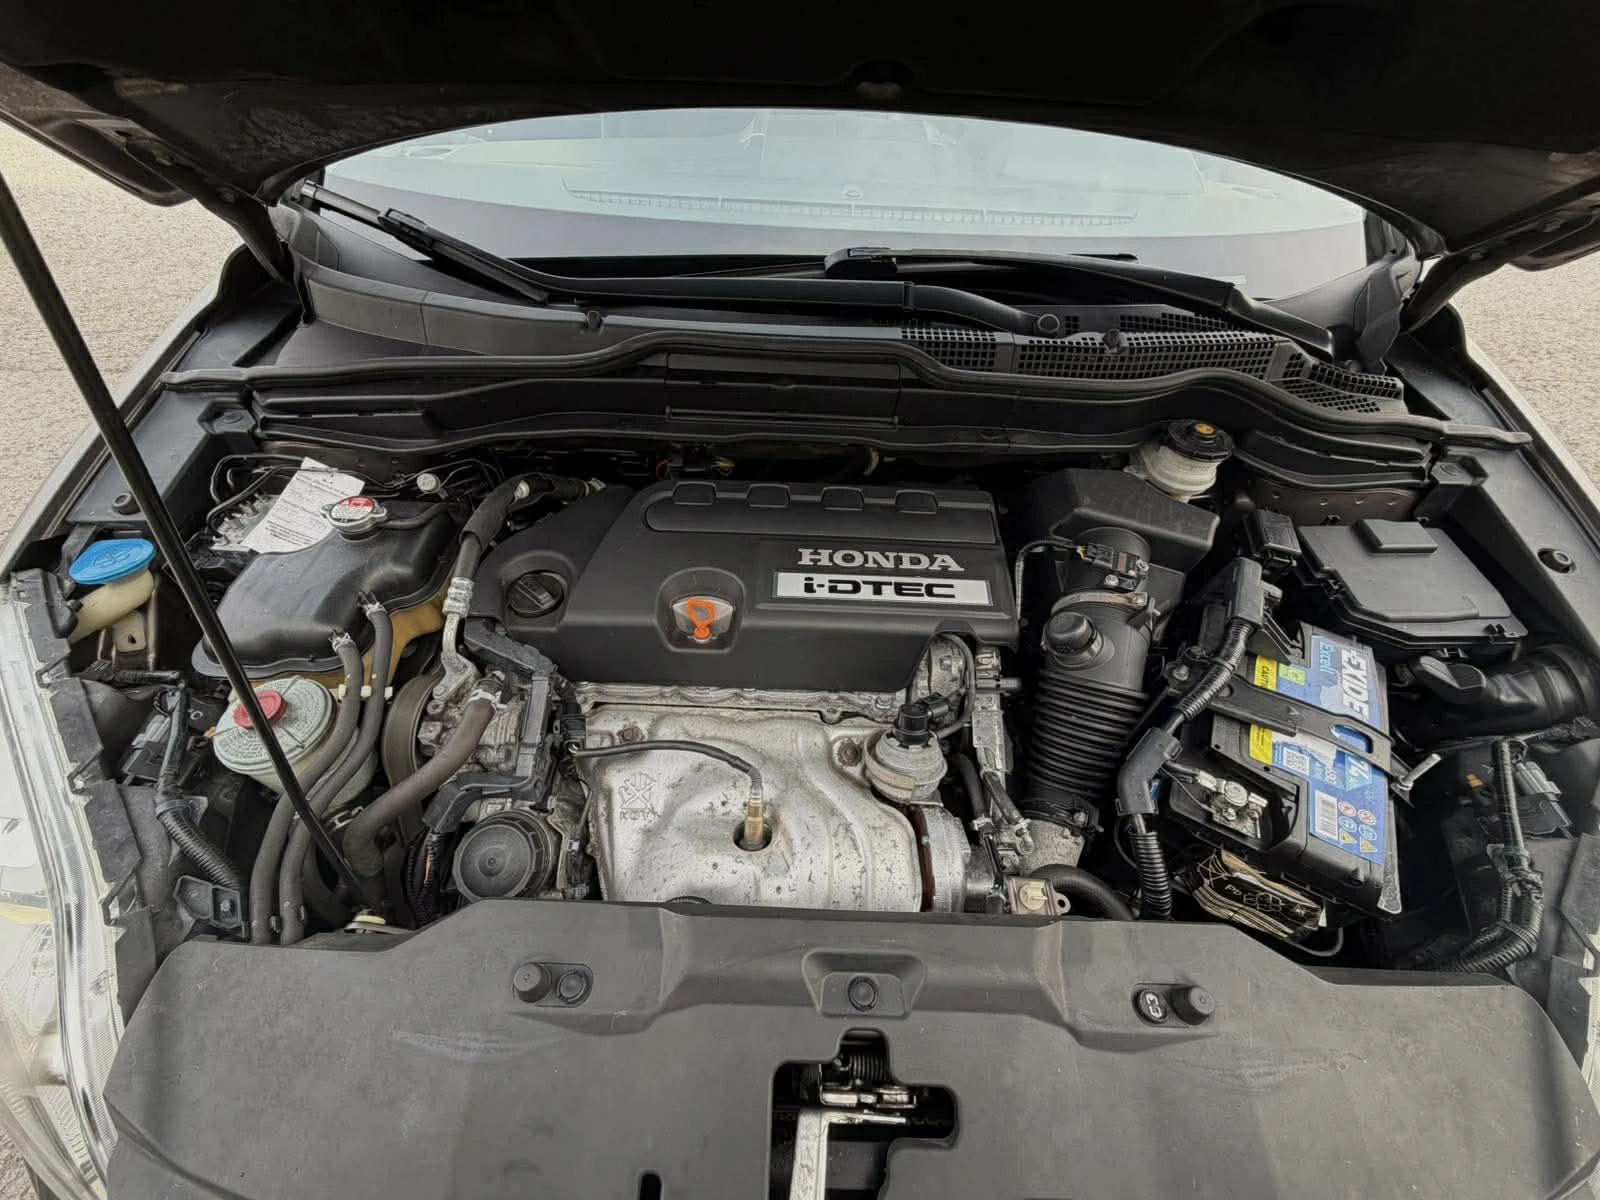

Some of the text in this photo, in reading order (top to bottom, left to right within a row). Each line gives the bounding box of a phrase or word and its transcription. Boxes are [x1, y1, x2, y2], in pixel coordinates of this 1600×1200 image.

[798, 548, 964, 571] HONDA
[804, 577, 956, 599] i-DTEC
[1320, 642, 1336, 675] Excell
[1342, 649, 1369, 721] EXIDE
